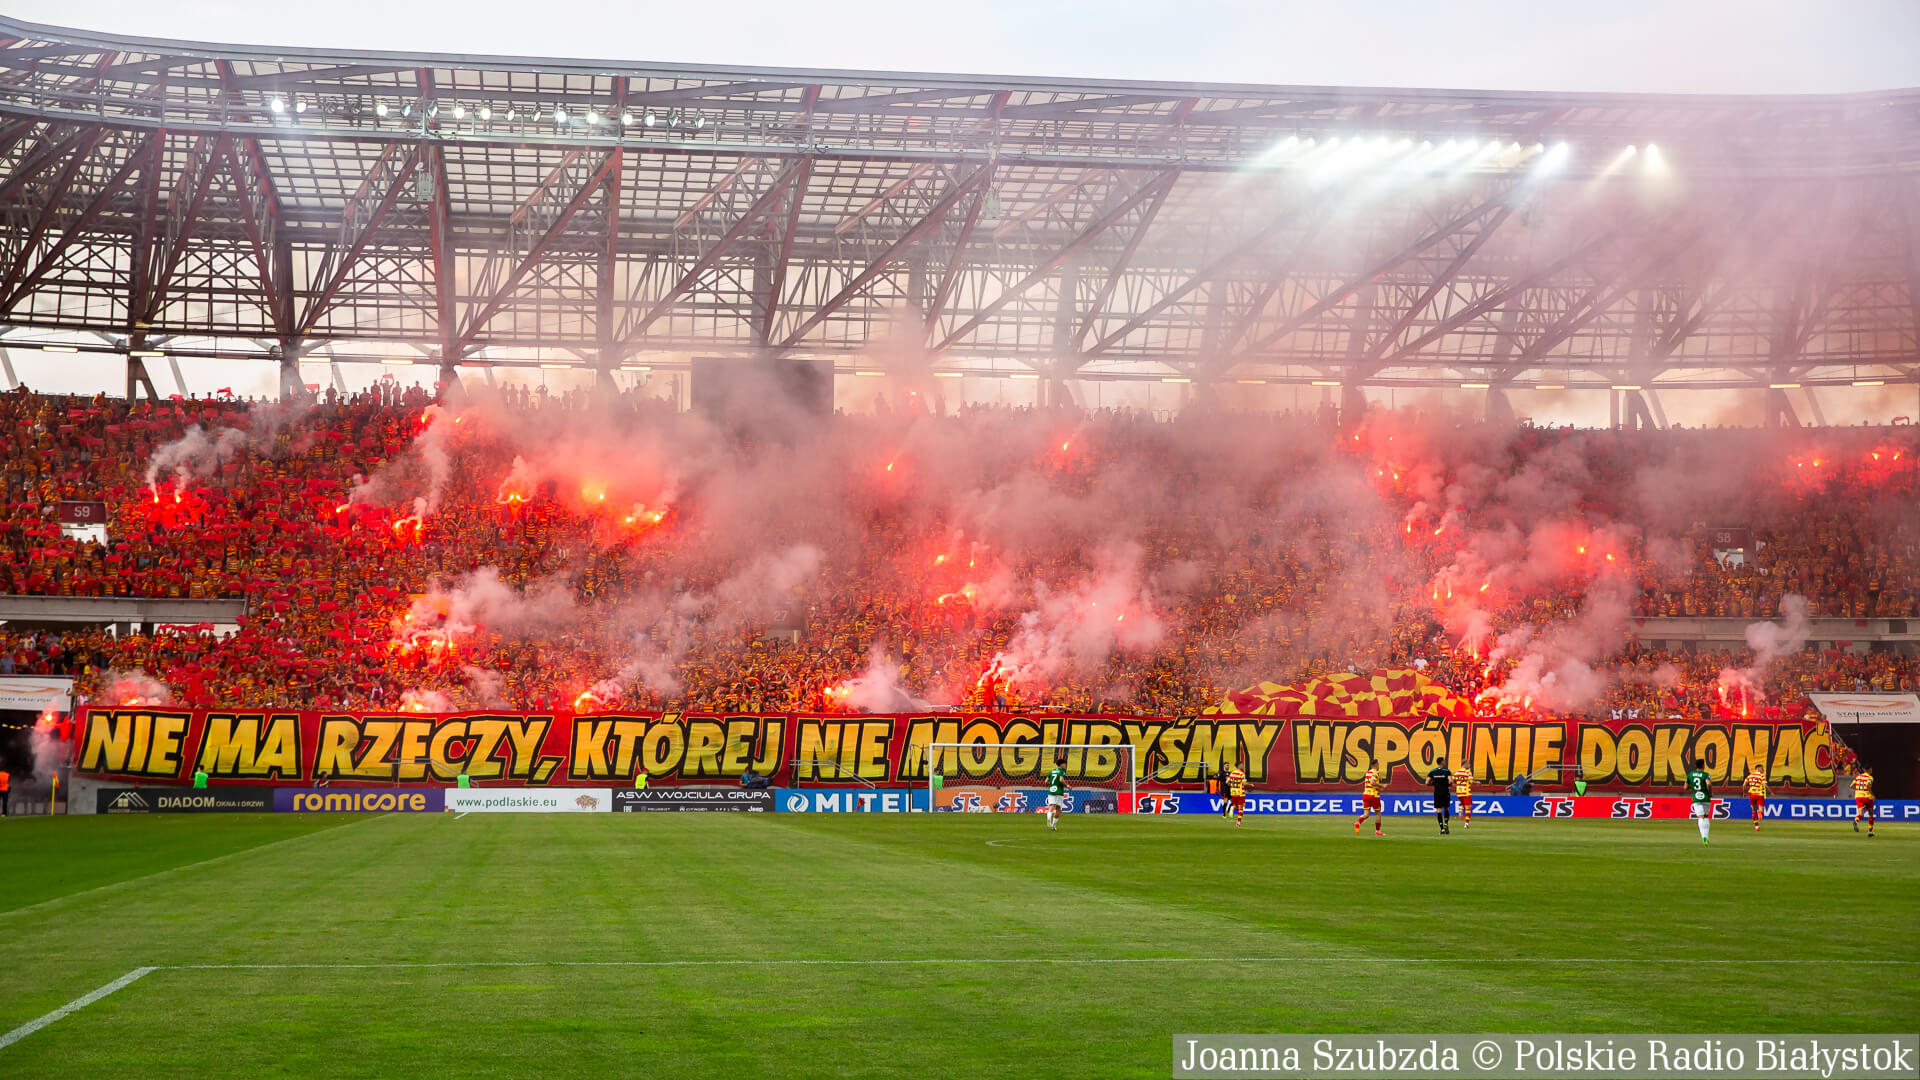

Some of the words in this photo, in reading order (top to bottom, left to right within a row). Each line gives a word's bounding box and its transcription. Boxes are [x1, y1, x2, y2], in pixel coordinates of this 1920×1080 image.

[74, 506, 90, 517] 59
[1717, 532, 1731, 543] 58
[775, 610, 788, 621] 27
[79, 711, 191, 777] NIE
[192, 713, 302, 779] MA
[313, 715, 565, 785] RZECZY,
[569, 712, 787, 780] KTÓREJ
[794, 718, 895, 782] NIE
[897, 717, 1283, 784] MOGLIBYŚMY
[1291, 717, 1565, 786] WSPÓLNIE
[1577, 720, 1836, 788] DOKONAĆ
[1052, 774, 1058, 785] 7
[1693, 777, 1701, 790] 3
[616, 791, 653, 799] ASW
[657, 791, 724, 799] WOJCIULA
[727, 791, 771, 799] GRUPA
[158, 797, 215, 808] DIADOM
[293, 793, 426, 812] romicore
[456, 797, 557, 808] www.podlaskie.eu
[815, 793, 923, 812] MITEL
[1137, 793, 1180, 814] STS
[1532, 797, 1574, 817] STS
[1611, 797, 1653, 818] STS
